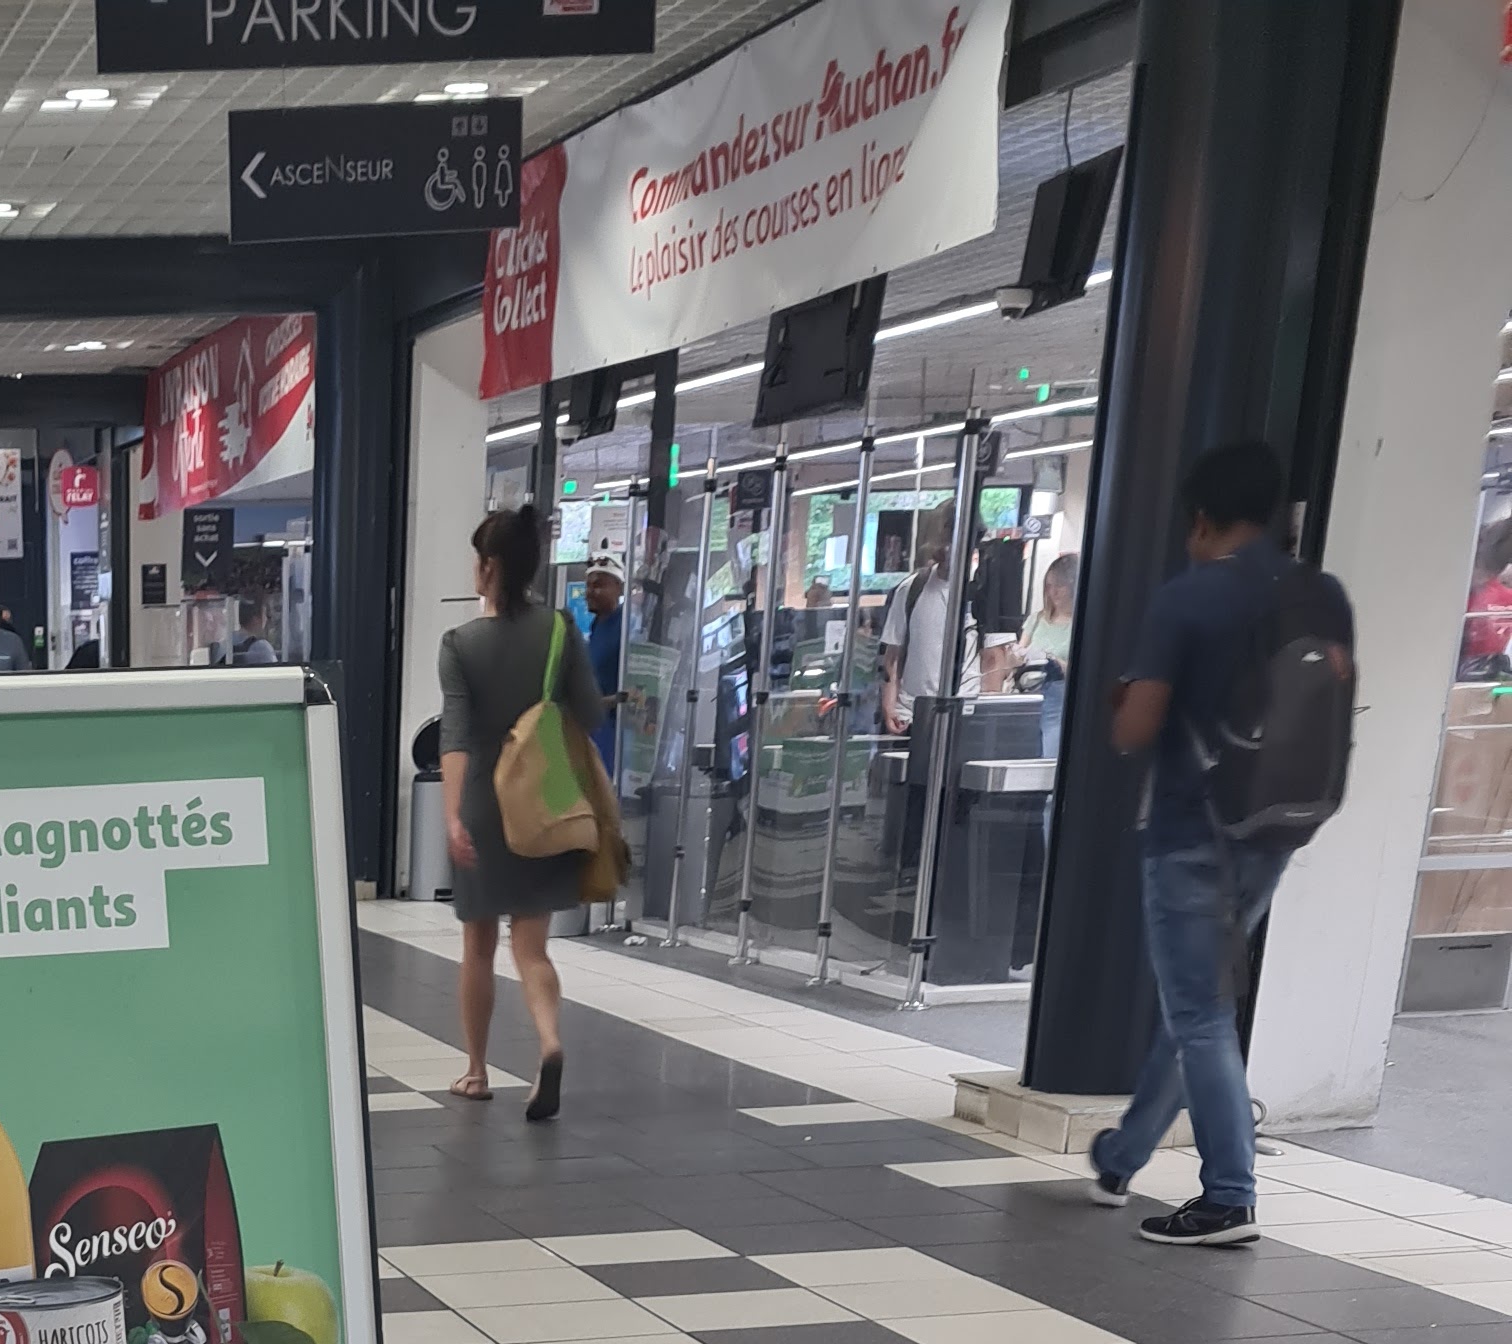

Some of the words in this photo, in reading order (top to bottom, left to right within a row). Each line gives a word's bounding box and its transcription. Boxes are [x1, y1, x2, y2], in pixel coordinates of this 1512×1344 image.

[206, 0, 478, 45] PARKING
[270, 155, 393, 187] ASCENSEUR
[629, 113, 770, 224] Commandez
[772, 101, 813, 163] sur
[646, 217, 707, 300] plaisir
[711, 207, 739, 263] des
[743, 182, 820, 250] courses
[826, 168, 853, 217] en
[44, 1210, 177, 1280] Senseo
